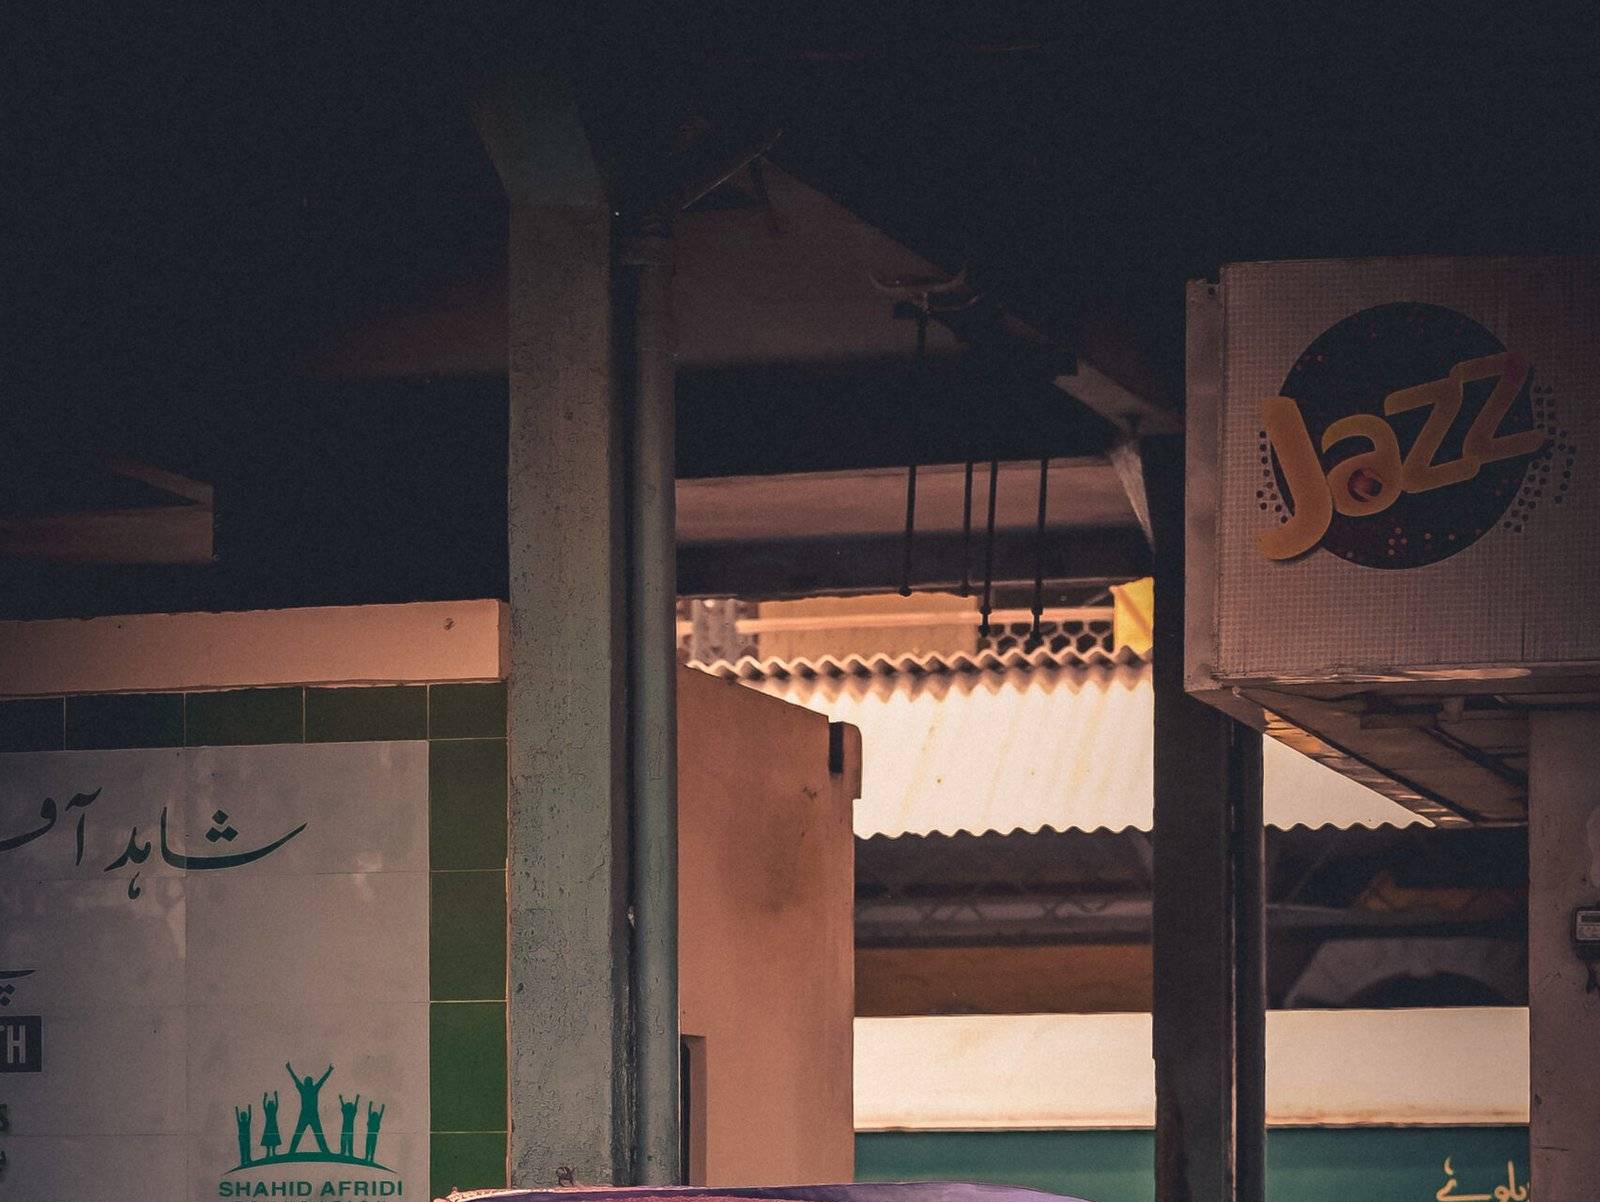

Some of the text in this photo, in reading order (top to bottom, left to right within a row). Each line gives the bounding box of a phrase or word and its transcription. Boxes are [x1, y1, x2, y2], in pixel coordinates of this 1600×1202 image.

[1256, 350, 1546, 560] Jazz
[103, 806, 308, 900] شاہد
[218, 1181, 404, 1198] SHAHID AFRIDI
